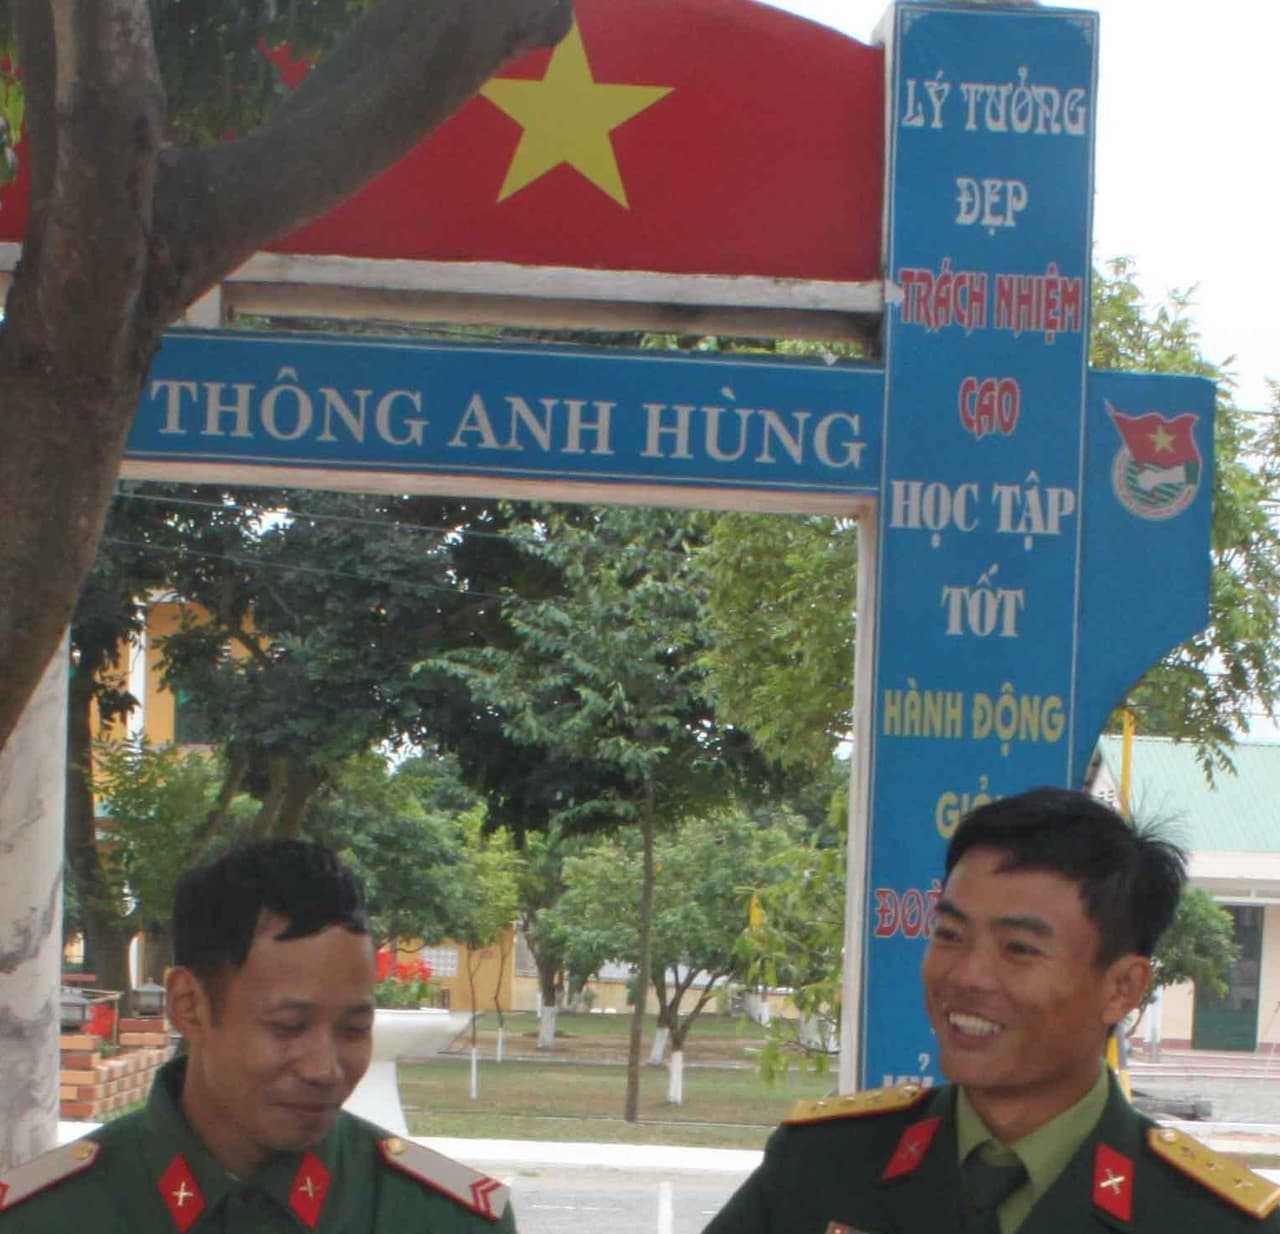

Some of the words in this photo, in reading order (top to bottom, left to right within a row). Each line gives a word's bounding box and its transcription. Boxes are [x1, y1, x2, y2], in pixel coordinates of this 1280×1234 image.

[901, 69, 951, 128] LÝ
[959, 65, 1087, 136] TƯỞNG
[955, 176, 1029, 236] ĐẸP
[899, 256, 987, 335] TRÁCH
[994, 262, 1082, 344] NHIỆM
[150, 366, 430, 446] THÔNG
[447, 393, 617, 455] ANH
[640, 386, 867, 469] HÙNG
[958, 376, 1020, 440] CAO
[889, 479, 981, 548] HỌC
[992, 470, 1076, 550] TẬP
[942, 564, 1025, 638] TỐT
[883, 678, 963, 739] HÀNH
[972, 682, 1065, 756] ĐỘNG
